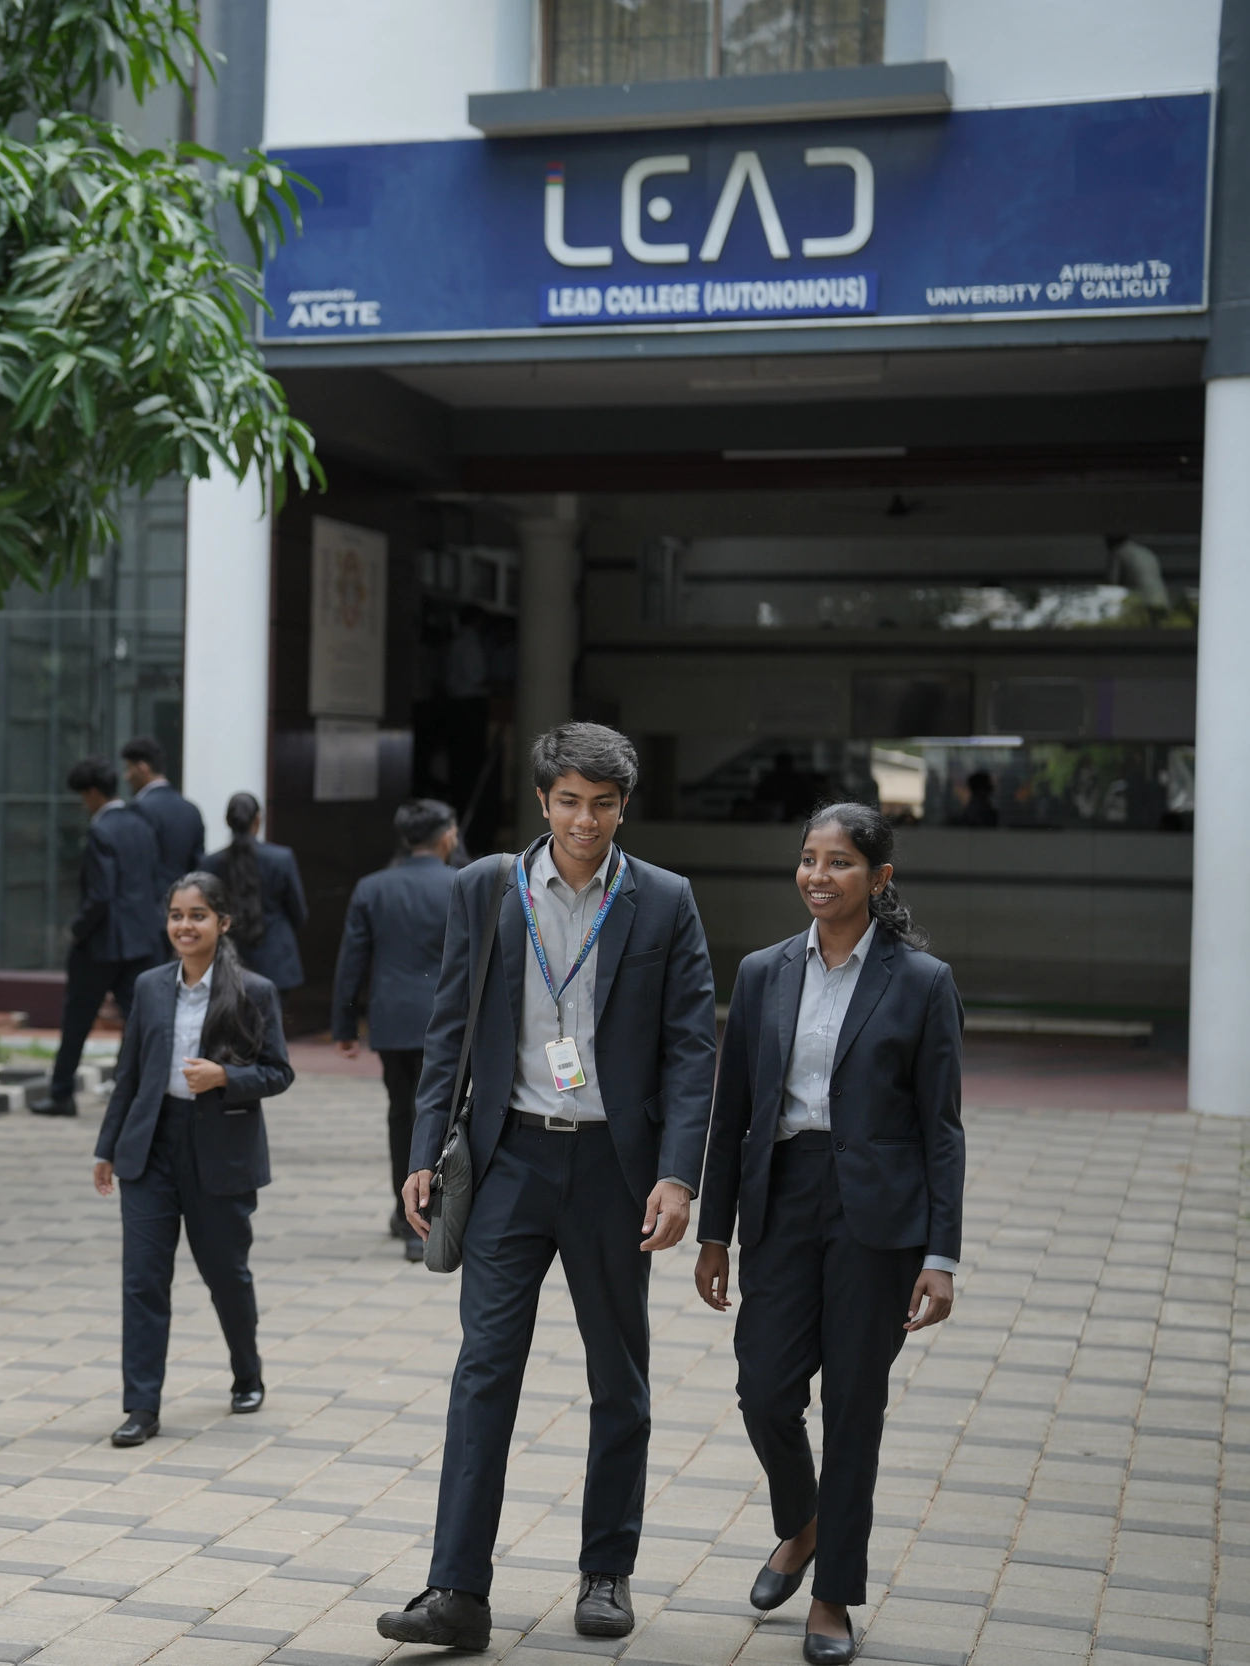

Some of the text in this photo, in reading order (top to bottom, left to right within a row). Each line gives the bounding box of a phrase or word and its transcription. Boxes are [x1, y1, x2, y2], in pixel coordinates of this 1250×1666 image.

[544, 146, 875, 267] LEAD
[1059, 260, 1171, 283] Affiliated To
[548, 275, 867, 317] LEAD COLLEGE (AUTONOMOUS)
[926, 278, 1171, 306] UNIVERSITY OF CALICUT
[287, 300, 382, 328] AICTE
[519, 881, 535, 925] MANAGEMENT
[586, 929, 597, 946] LEAD
[593, 902, 610, 929] COLLEGE
[606, 893, 615, 903] OF
[533, 934, 545, 966] COLLEGE
[541, 964, 550, 981] LEAD
